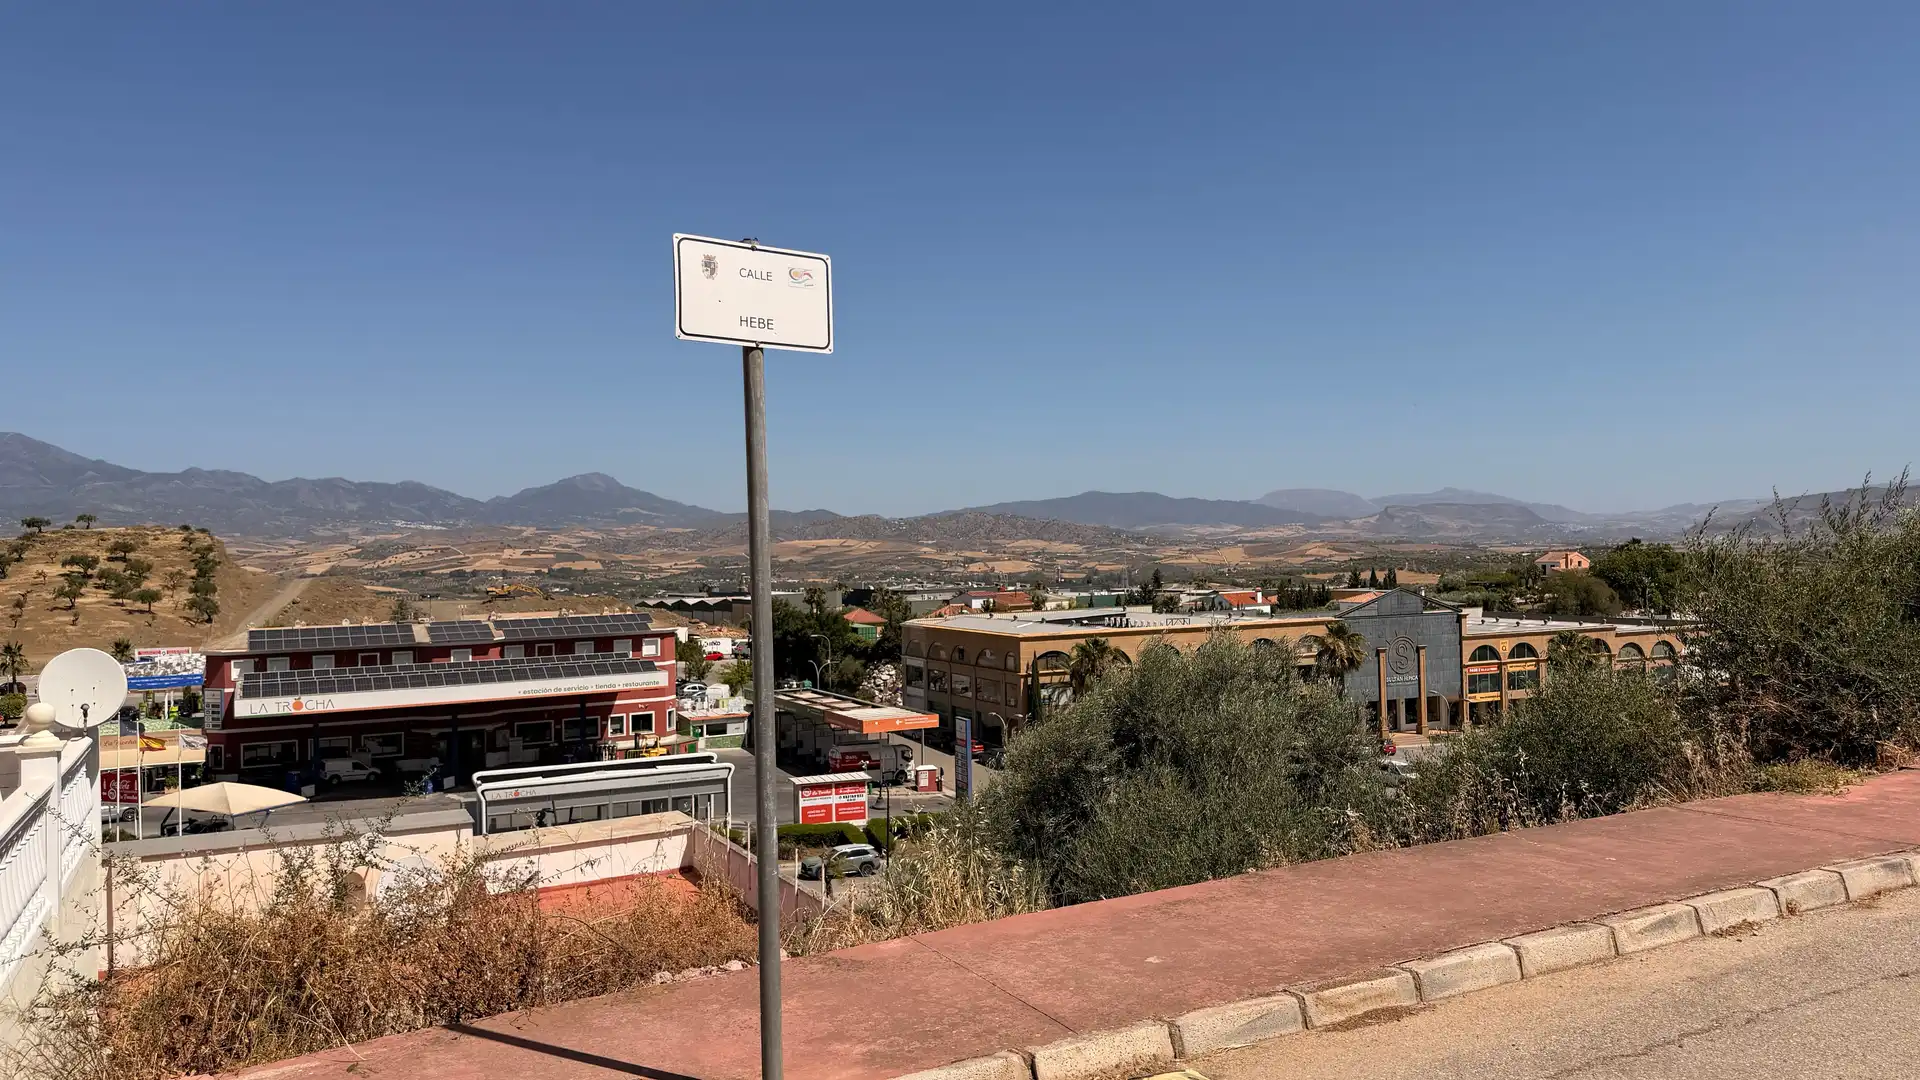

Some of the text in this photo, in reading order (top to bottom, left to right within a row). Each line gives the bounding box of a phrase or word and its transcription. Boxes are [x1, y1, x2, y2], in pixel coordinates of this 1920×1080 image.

[739, 267, 773, 282] CALLE
[739, 315, 774, 331] HEBE
[553, 684, 563, 693] de
[563, 683, 589, 692] servicio
[595, 682, 616, 690] tienda
[622, 679, 660, 688] restaurante
[250, 703, 268, 715] LA
